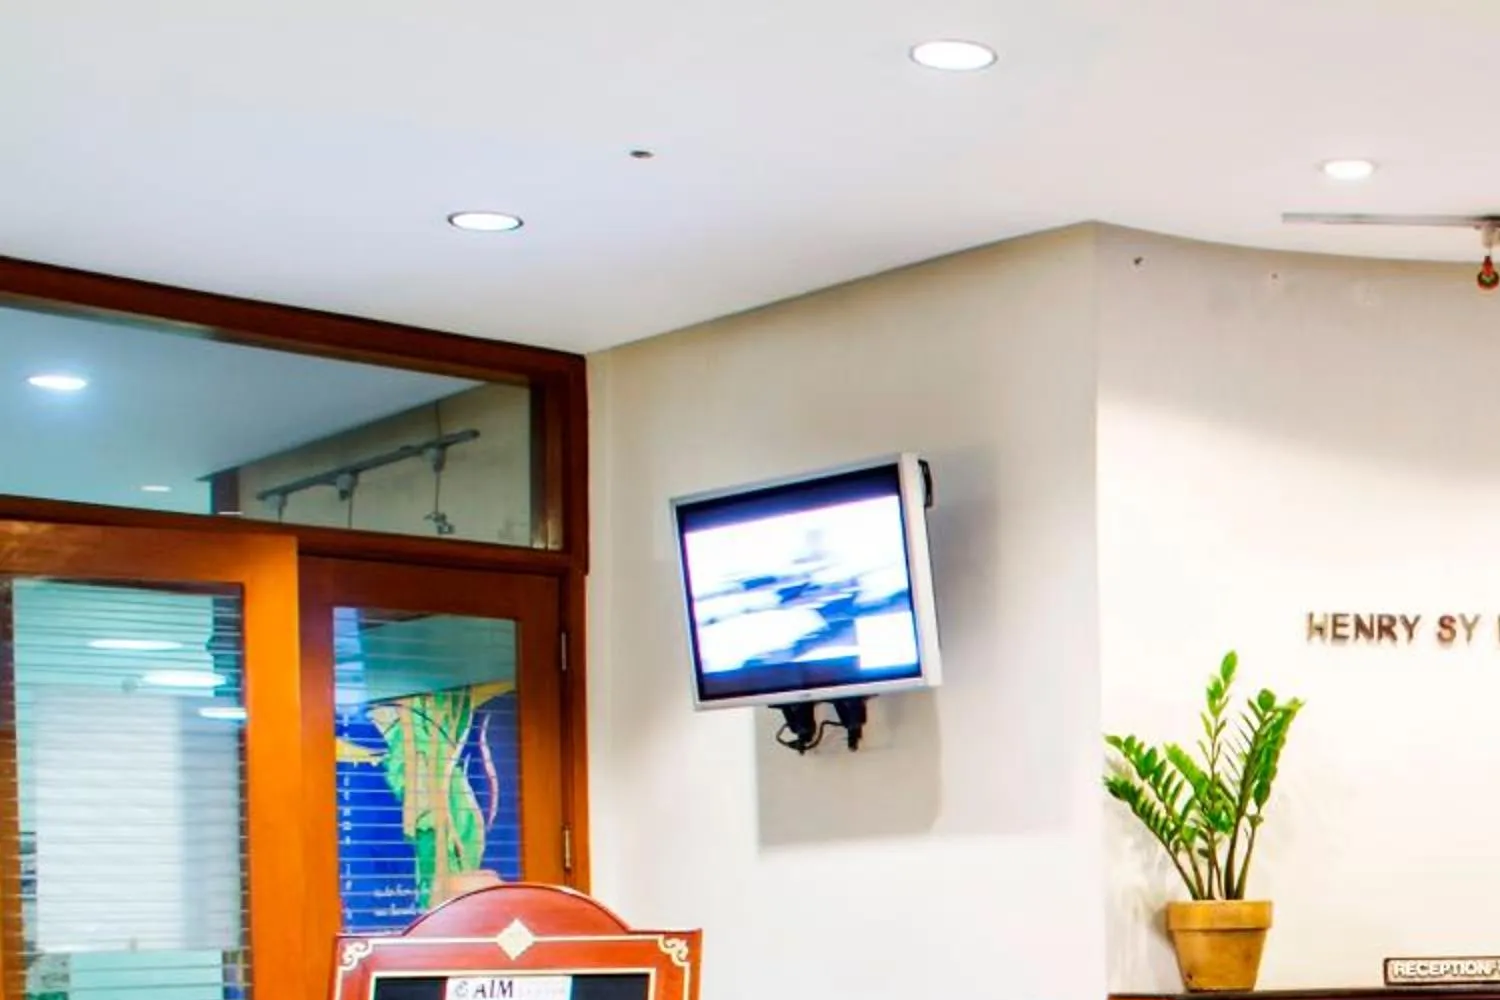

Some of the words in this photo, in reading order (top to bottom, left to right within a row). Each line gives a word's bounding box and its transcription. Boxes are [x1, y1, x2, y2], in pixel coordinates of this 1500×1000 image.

[1306, 612, 1421, 642] HENRY
[1436, 613, 1481, 643] SY
[474, 979, 514, 999] AIM
